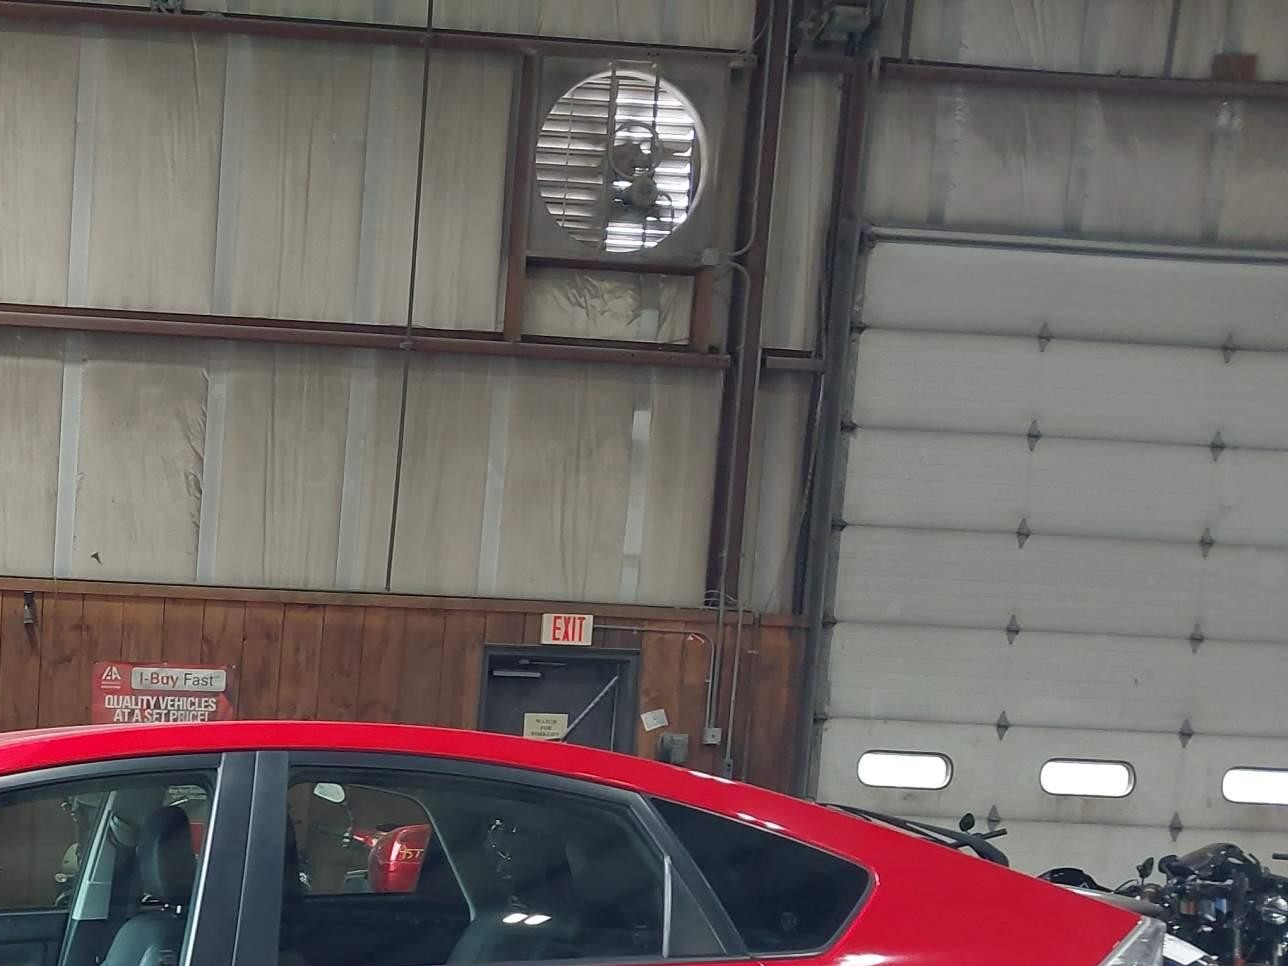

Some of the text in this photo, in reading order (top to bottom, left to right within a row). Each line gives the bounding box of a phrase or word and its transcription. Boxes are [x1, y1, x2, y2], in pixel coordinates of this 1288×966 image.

[552, 615, 586, 642] EXIT
[139, 671, 214, 689] I-Buy Fast
[104, 694, 217, 711] QUALITY VEHICLES
[113, 709, 131, 722] AT
[132, 710, 142, 722] A
[144, 710, 168, 723] SET
